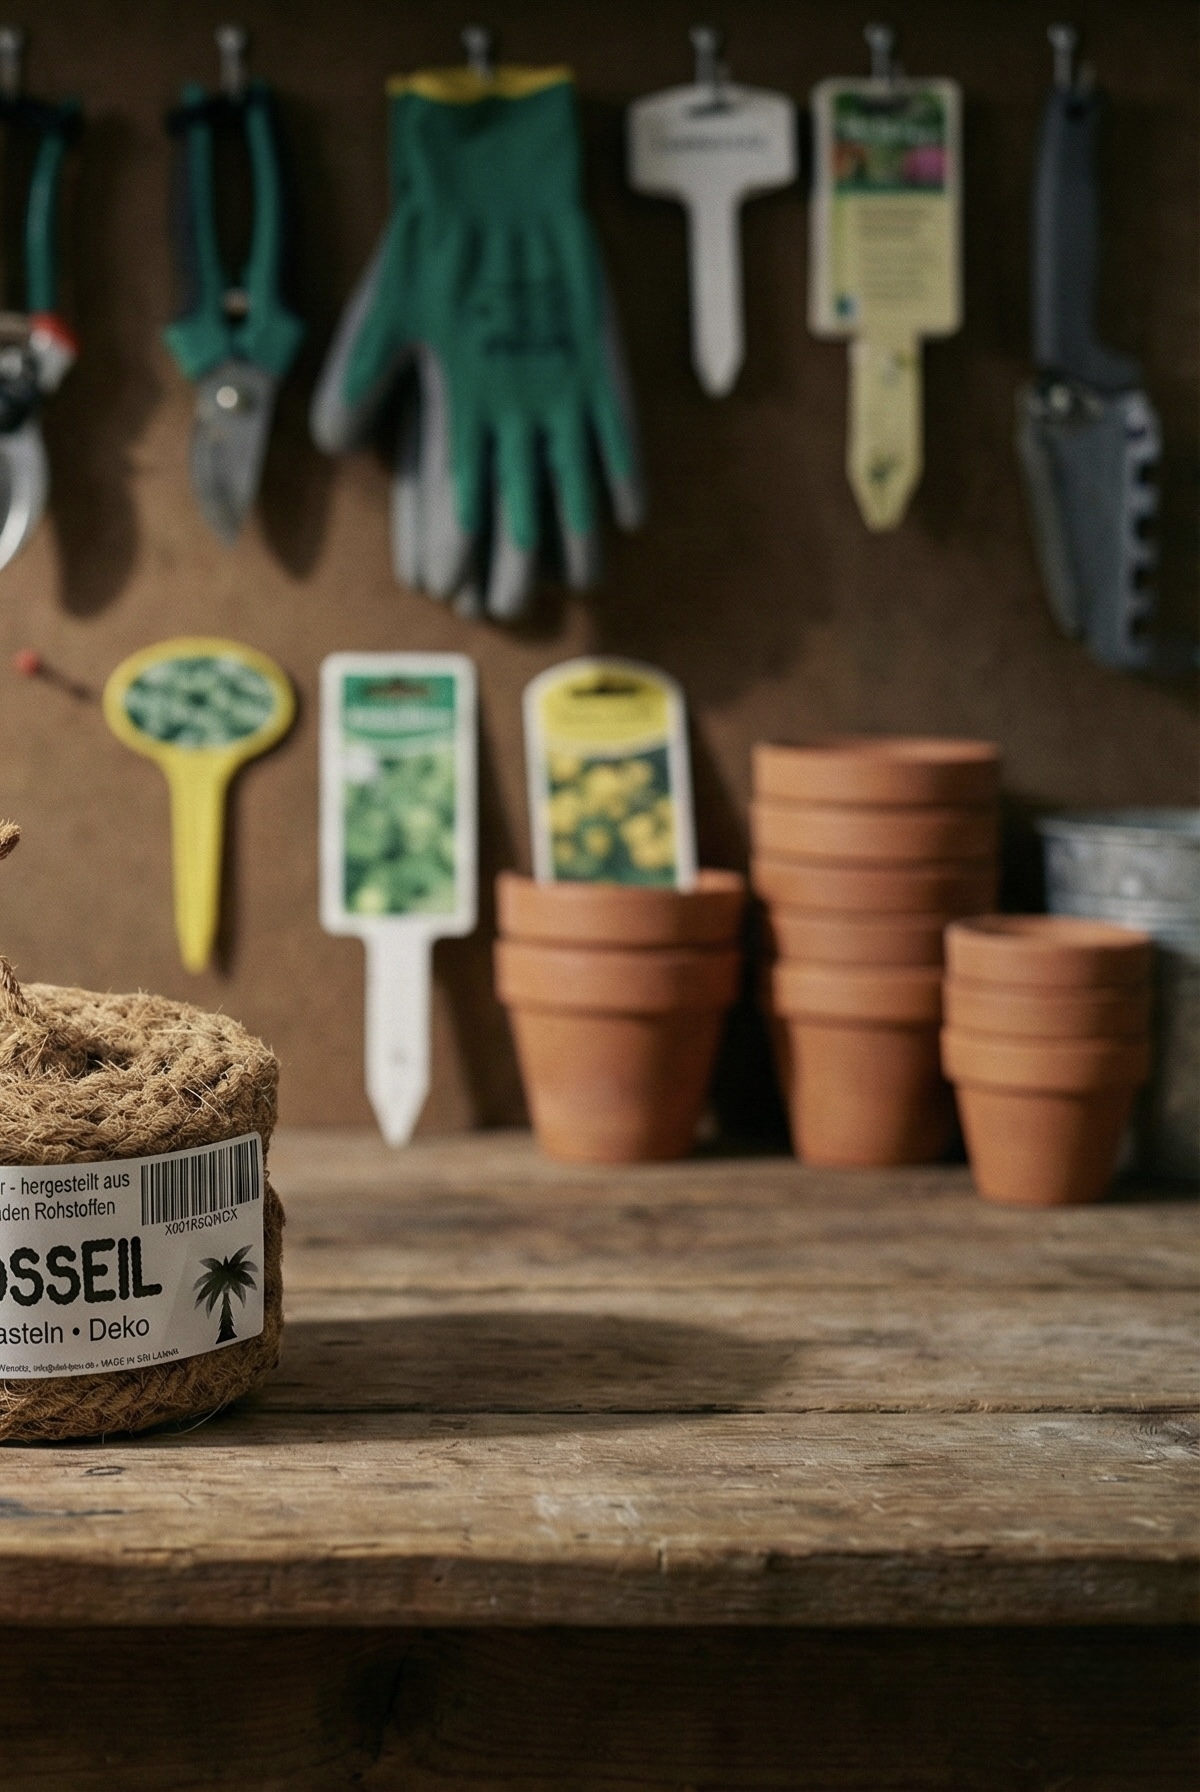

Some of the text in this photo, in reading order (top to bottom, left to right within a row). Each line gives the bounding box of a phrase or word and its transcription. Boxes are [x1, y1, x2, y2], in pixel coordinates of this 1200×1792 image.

[103, 1173, 131, 1190] aus
[34, 1198, 116, 1221] Rohstoffen
[89, 1314, 150, 1342] Deko
